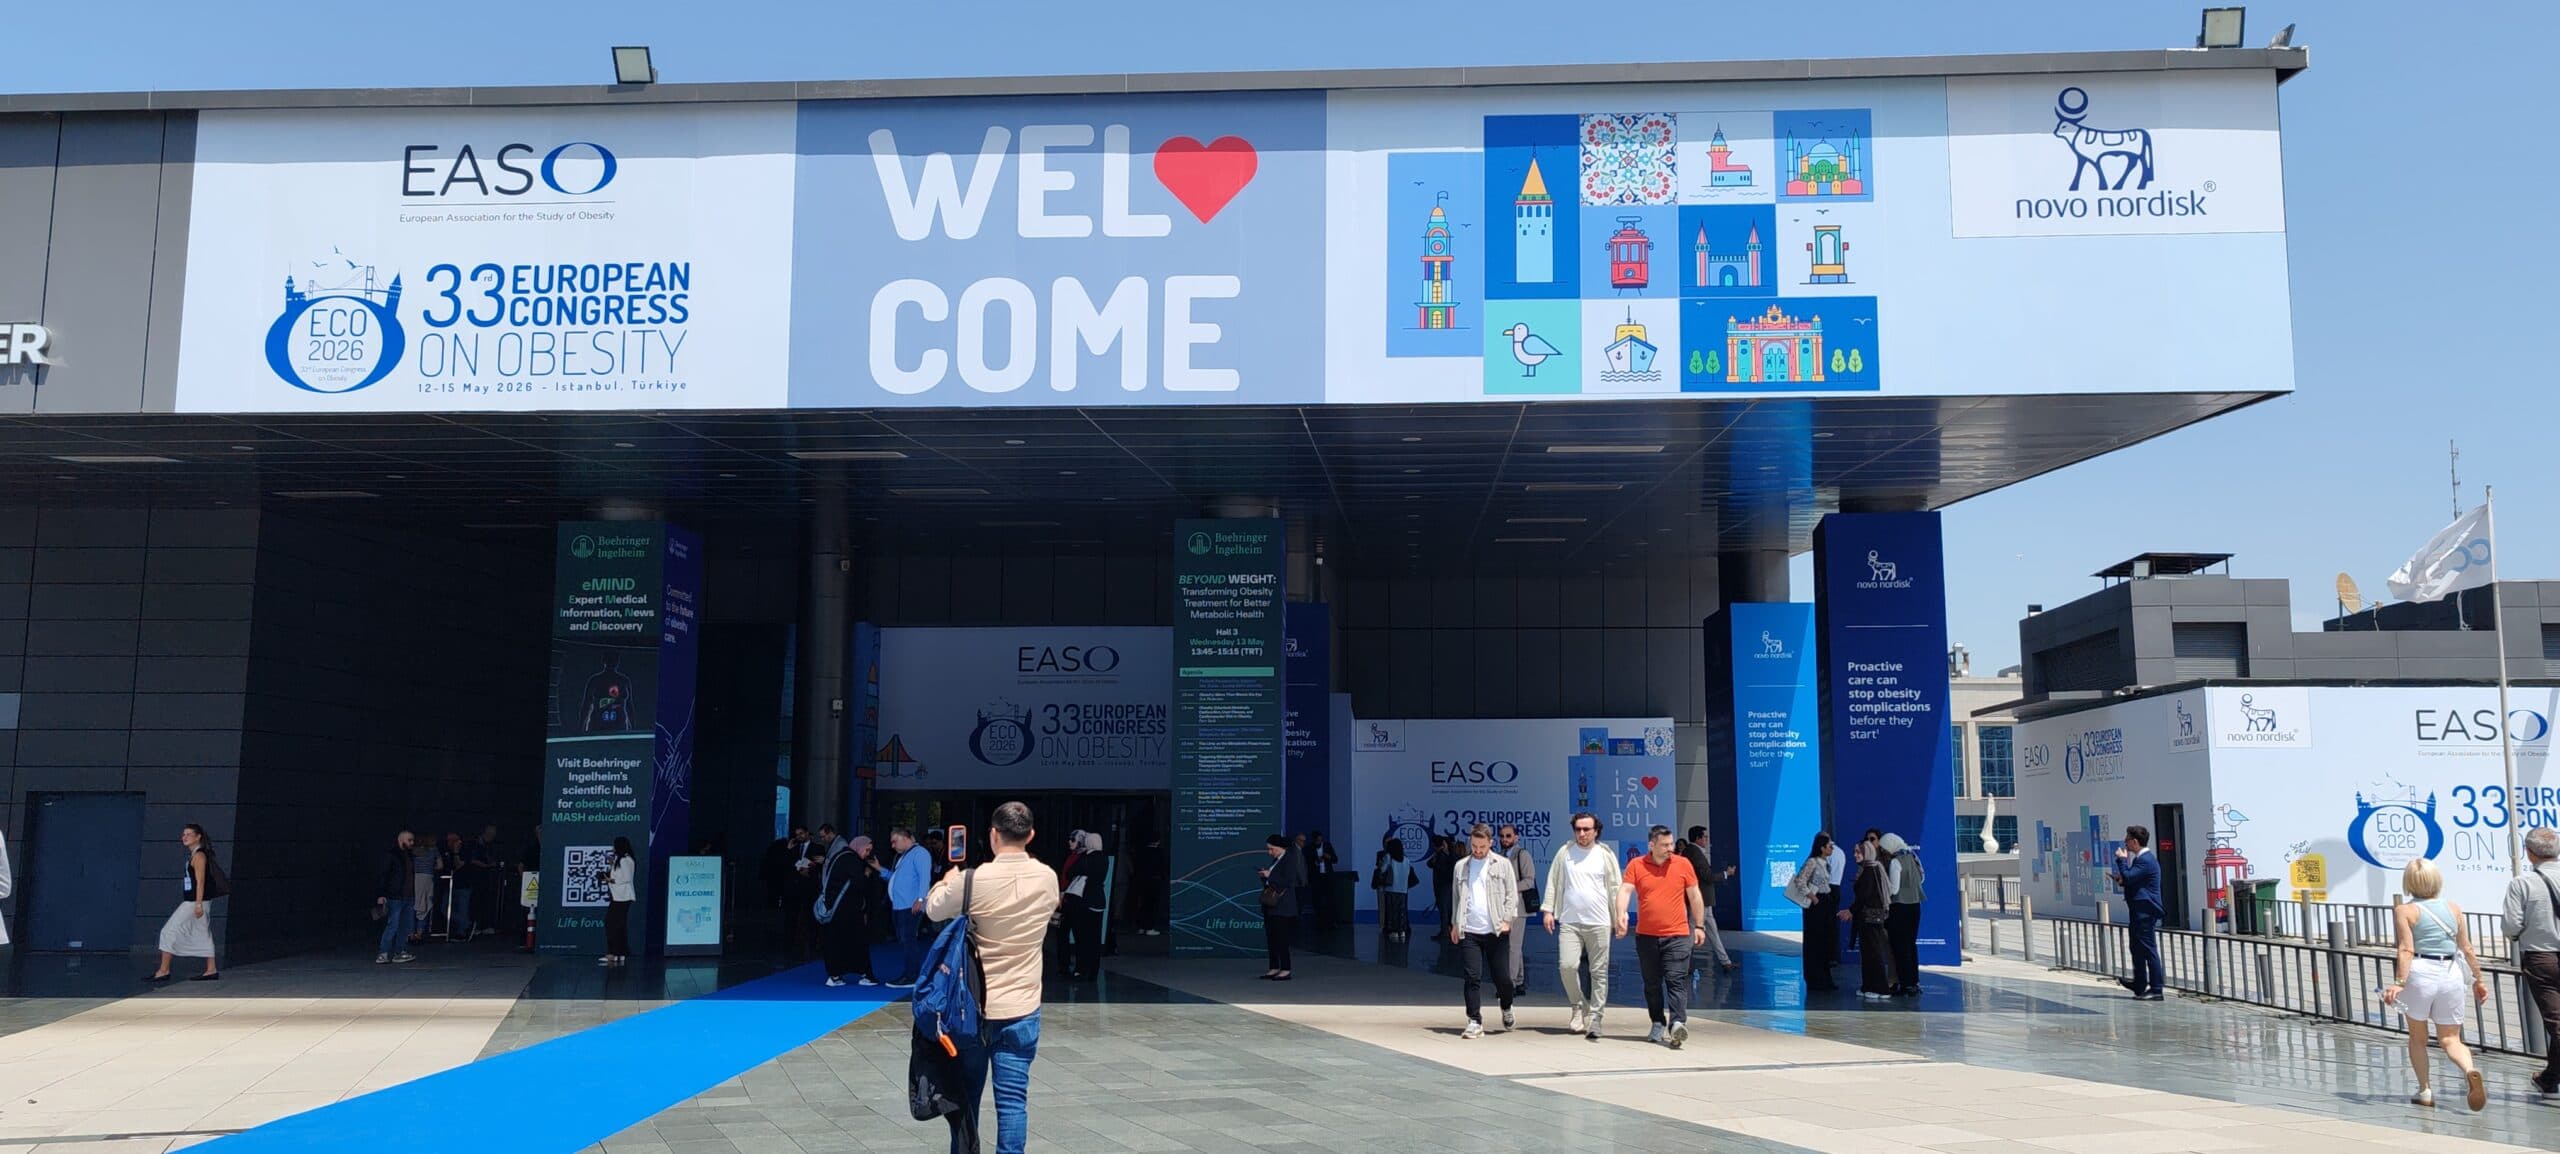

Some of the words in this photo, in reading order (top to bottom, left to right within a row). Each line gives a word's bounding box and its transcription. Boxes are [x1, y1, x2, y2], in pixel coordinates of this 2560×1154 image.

[402, 142, 617, 196] EASO
[868, 124, 1171, 241] WEL
[2016, 198, 2087, 219] novo
[400, 213, 444, 223] European
[446, 212, 500, 222] Association
[503, 212, 516, 221] for
[519, 212, 534, 221] the
[536, 212, 564, 223] Study
[567, 211, 576, 221] of
[578, 210, 615, 222] Obesity
[511, 262, 690, 295] EUROPEAN
[509, 294, 690, 326] CONGRESS
[310, 309, 367, 337] ECO
[869, 275, 1241, 395] COME
[308, 339, 364, 361] 2026
[419, 332, 479, 378] ON
[497, 330, 688, 377] OBESITY
[418, 383, 455, 393] 12-15
[463, 383, 489, 395] May
[497, 382, 532, 392] 2026
[598, 535, 650, 548] Boehringer
[1215, 532, 1268, 545] Boehringer
[598, 548, 645, 559] Ingelheim
[1215, 545, 1262, 557] Ingelheim
[582, 578, 636, 591] eMIND
[1178, 575, 1226, 585] BEYOND
[1228, 574, 1277, 584] WEIGHT:
[1856, 581, 1878, 589] novo
[1182, 587, 1238, 598] Transforming
[1239, 587, 1273, 598] Obesity
[569, 595, 603, 606] Expert
[605, 594, 648, 604] Medical
[1184, 599, 1229, 608] Treatment
[1230, 598, 1242, 608] for
[1243, 599, 1271, 608] Better
[560, 608, 623, 619] Information,
[625, 608, 655, 617] News
[1190, 610, 1235, 619] Metabolic
[1236, 610, 1265, 619] Health
[570, 621, 590, 631] and
[592, 621, 644, 633] Discovery
[1216, 628, 1231, 636] Hall
[1232, 628, 1239, 636] 3
[1190, 638, 1235, 647] Wednesday
[1247, 638, 1264, 647] May
[1018, 646, 1120, 672] EASO
[1847, 661, 1903, 671] Proactive
[1848, 677, 1873, 685] care
[1876, 677, 1897, 685] can
[1848, 689, 1875, 701] stop
[1877, 688, 1921, 701] obesity
[1748, 711, 1787, 719] Proactive
[1849, 702, 1931, 715] complications
[1042, 704, 1081, 735] 33
[1083, 703, 1166, 719] EUROPEAN
[1850, 716, 1886, 726] before
[1888, 715, 1914, 728] they
[2416, 709, 2548, 742] EASO
[989, 725, 1017, 740] ECO
[1083, 720, 1166, 735] CONGRESS
[1749, 731, 1767, 740] stop
[1769, 730, 1800, 740] obesity
[2096, 728, 2122, 743] EUROPEAN
[2227, 733, 2254, 742] novo
[1041, 736, 1069, 759] ON
[1077, 736, 1166, 759] OBESITY
[1749, 739, 1807, 749] complications
[2097, 741, 2123, 755] CONGRESS
[1750, 750, 1775, 758] before
[1777, 750, 1795, 760] they
[2024, 744, 2049, 767] EASO
[557, 758, 581, 768] Visit
[583, 757, 642, 770] Boehringer
[1431, 761, 1518, 784] EASO
[562, 785, 611, 796] scientific
[613, 785, 632, 795] hub
[558, 799, 574, 809] for
[575, 799, 615, 811] obesity
[616, 799, 636, 809] and
[1612, 794, 1657, 809] TAN
[552, 813, 586, 823] MASH
[588, 812, 641, 822] education
[1479, 811, 1551, 824] EUROPEAN
[1612, 812, 1665, 827] BUL
[2376, 814, 2415, 833] ECO
[1400, 828, 1424, 840] ECO
[1403, 841, 1423, 850] 026
[2378, 834, 2416, 849] 2026
[2454, 831, 2496, 860] ON
[558, 917, 579, 928] Life
[1206, 919, 1226, 929] Life
[1229, 919, 1265, 929] forwar
